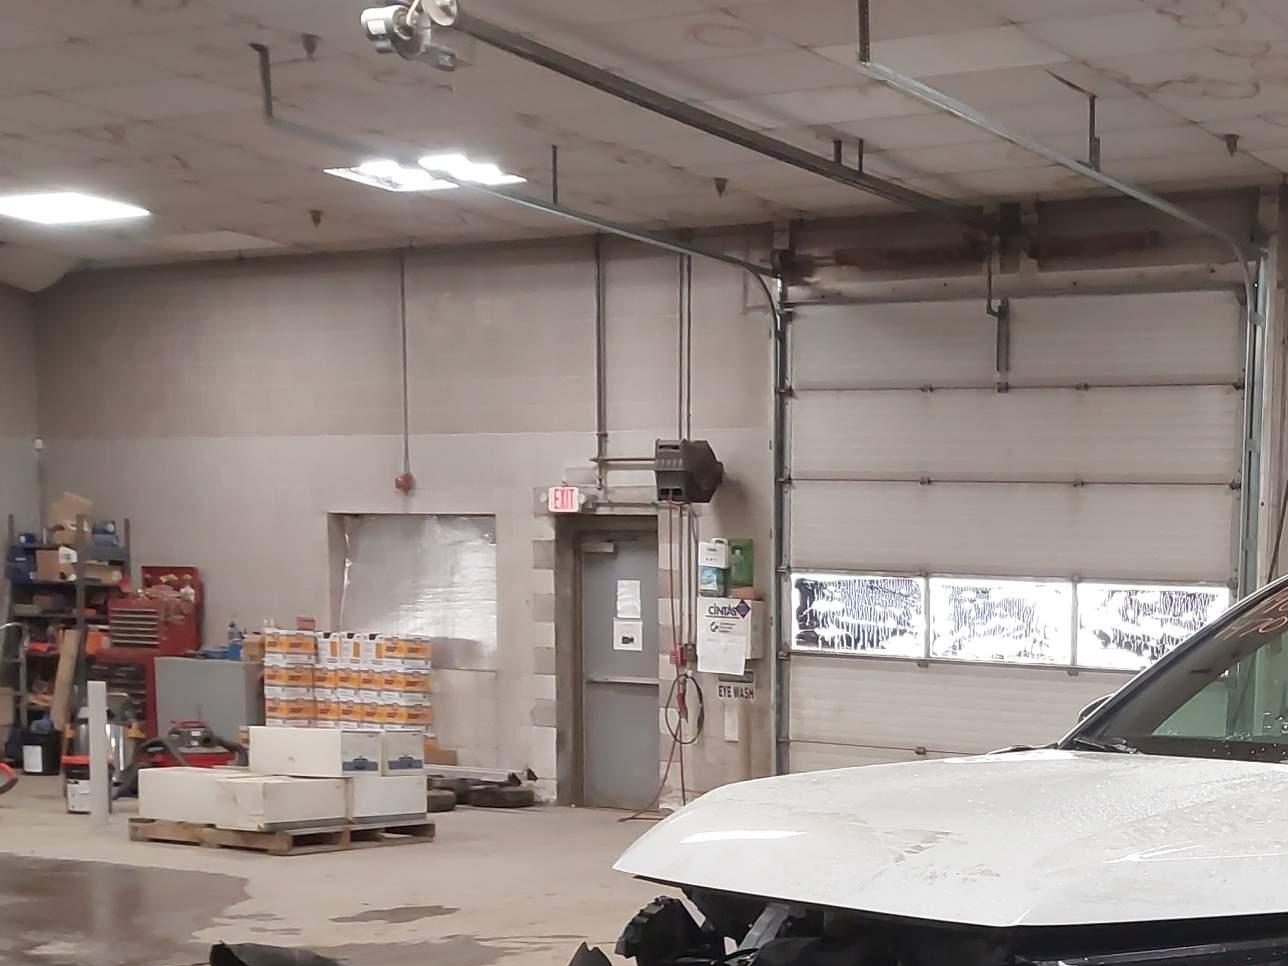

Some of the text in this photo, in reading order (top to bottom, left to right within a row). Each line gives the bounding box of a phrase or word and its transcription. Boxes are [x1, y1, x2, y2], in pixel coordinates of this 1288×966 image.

[554, 488, 575, 510] EXIT
[718, 685, 754, 699] EYE WASH
